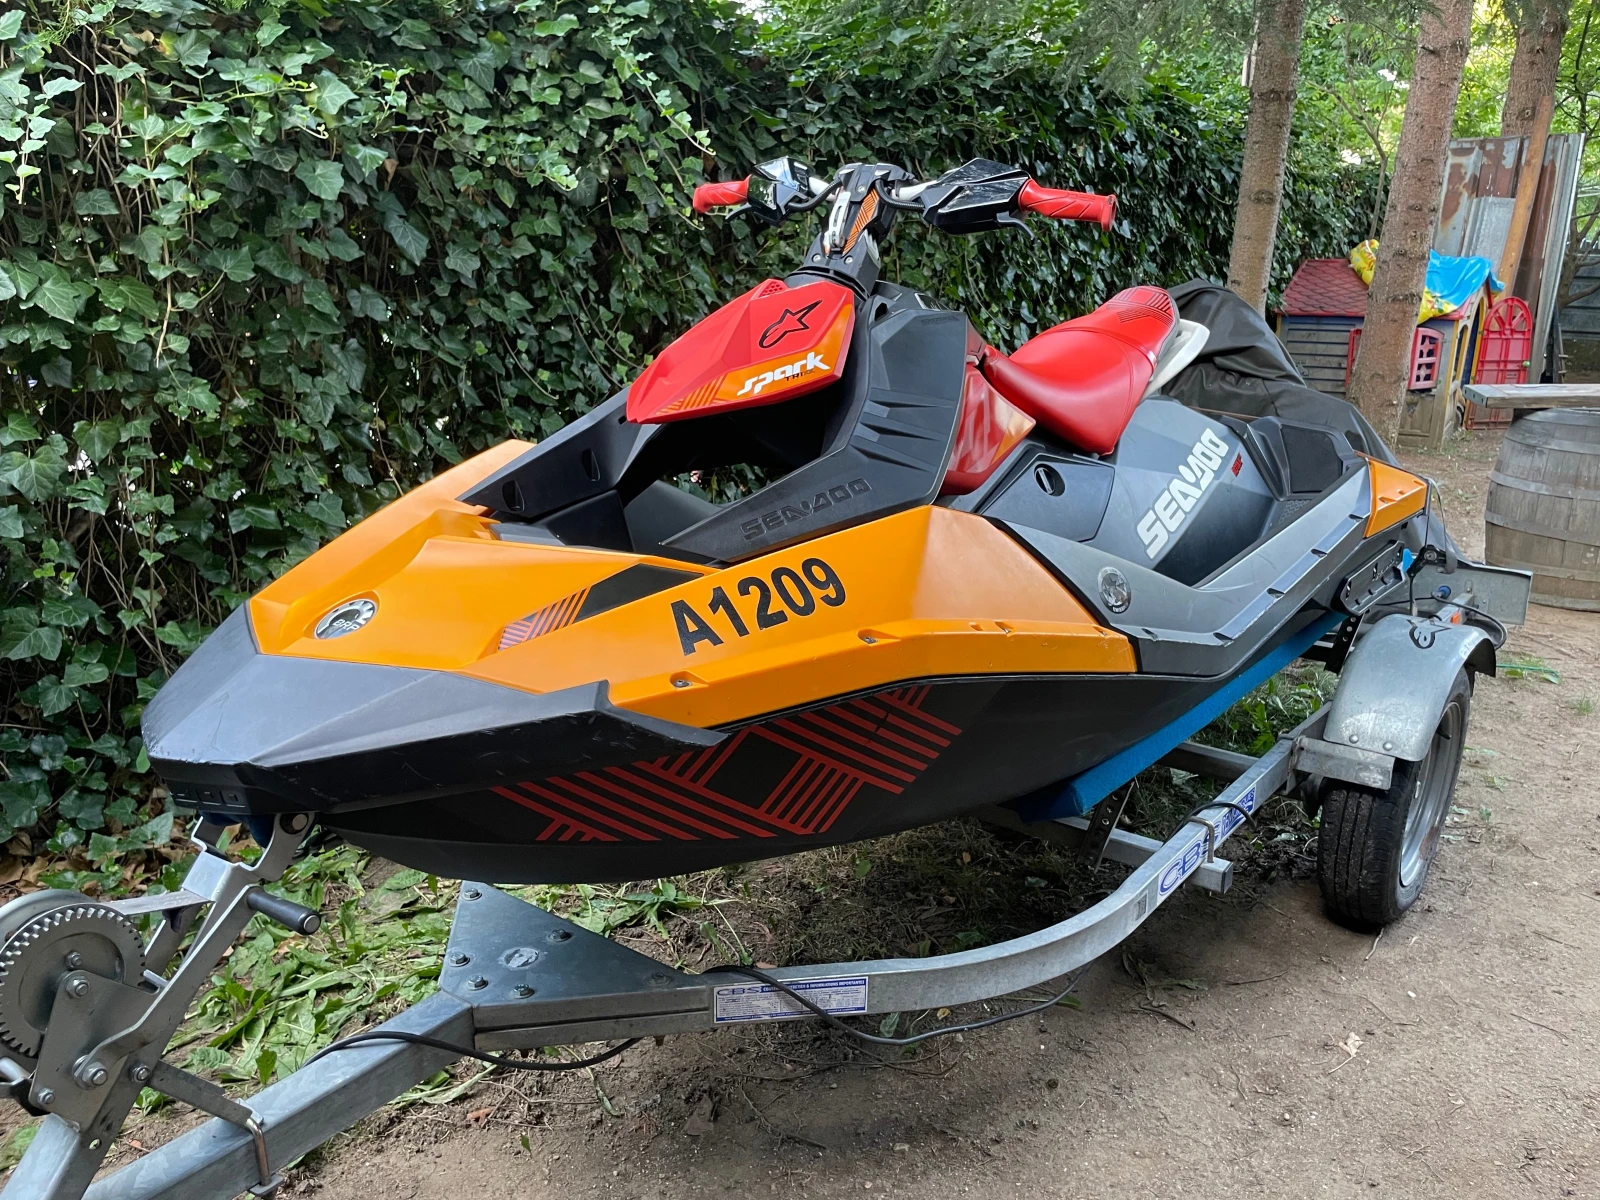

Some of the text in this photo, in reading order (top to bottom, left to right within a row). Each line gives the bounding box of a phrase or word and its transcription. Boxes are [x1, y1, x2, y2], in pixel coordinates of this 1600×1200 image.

[671, 558, 846, 656] A1209
[333, 619, 360, 630] BRP
[717, 986, 762, 996] CBS
